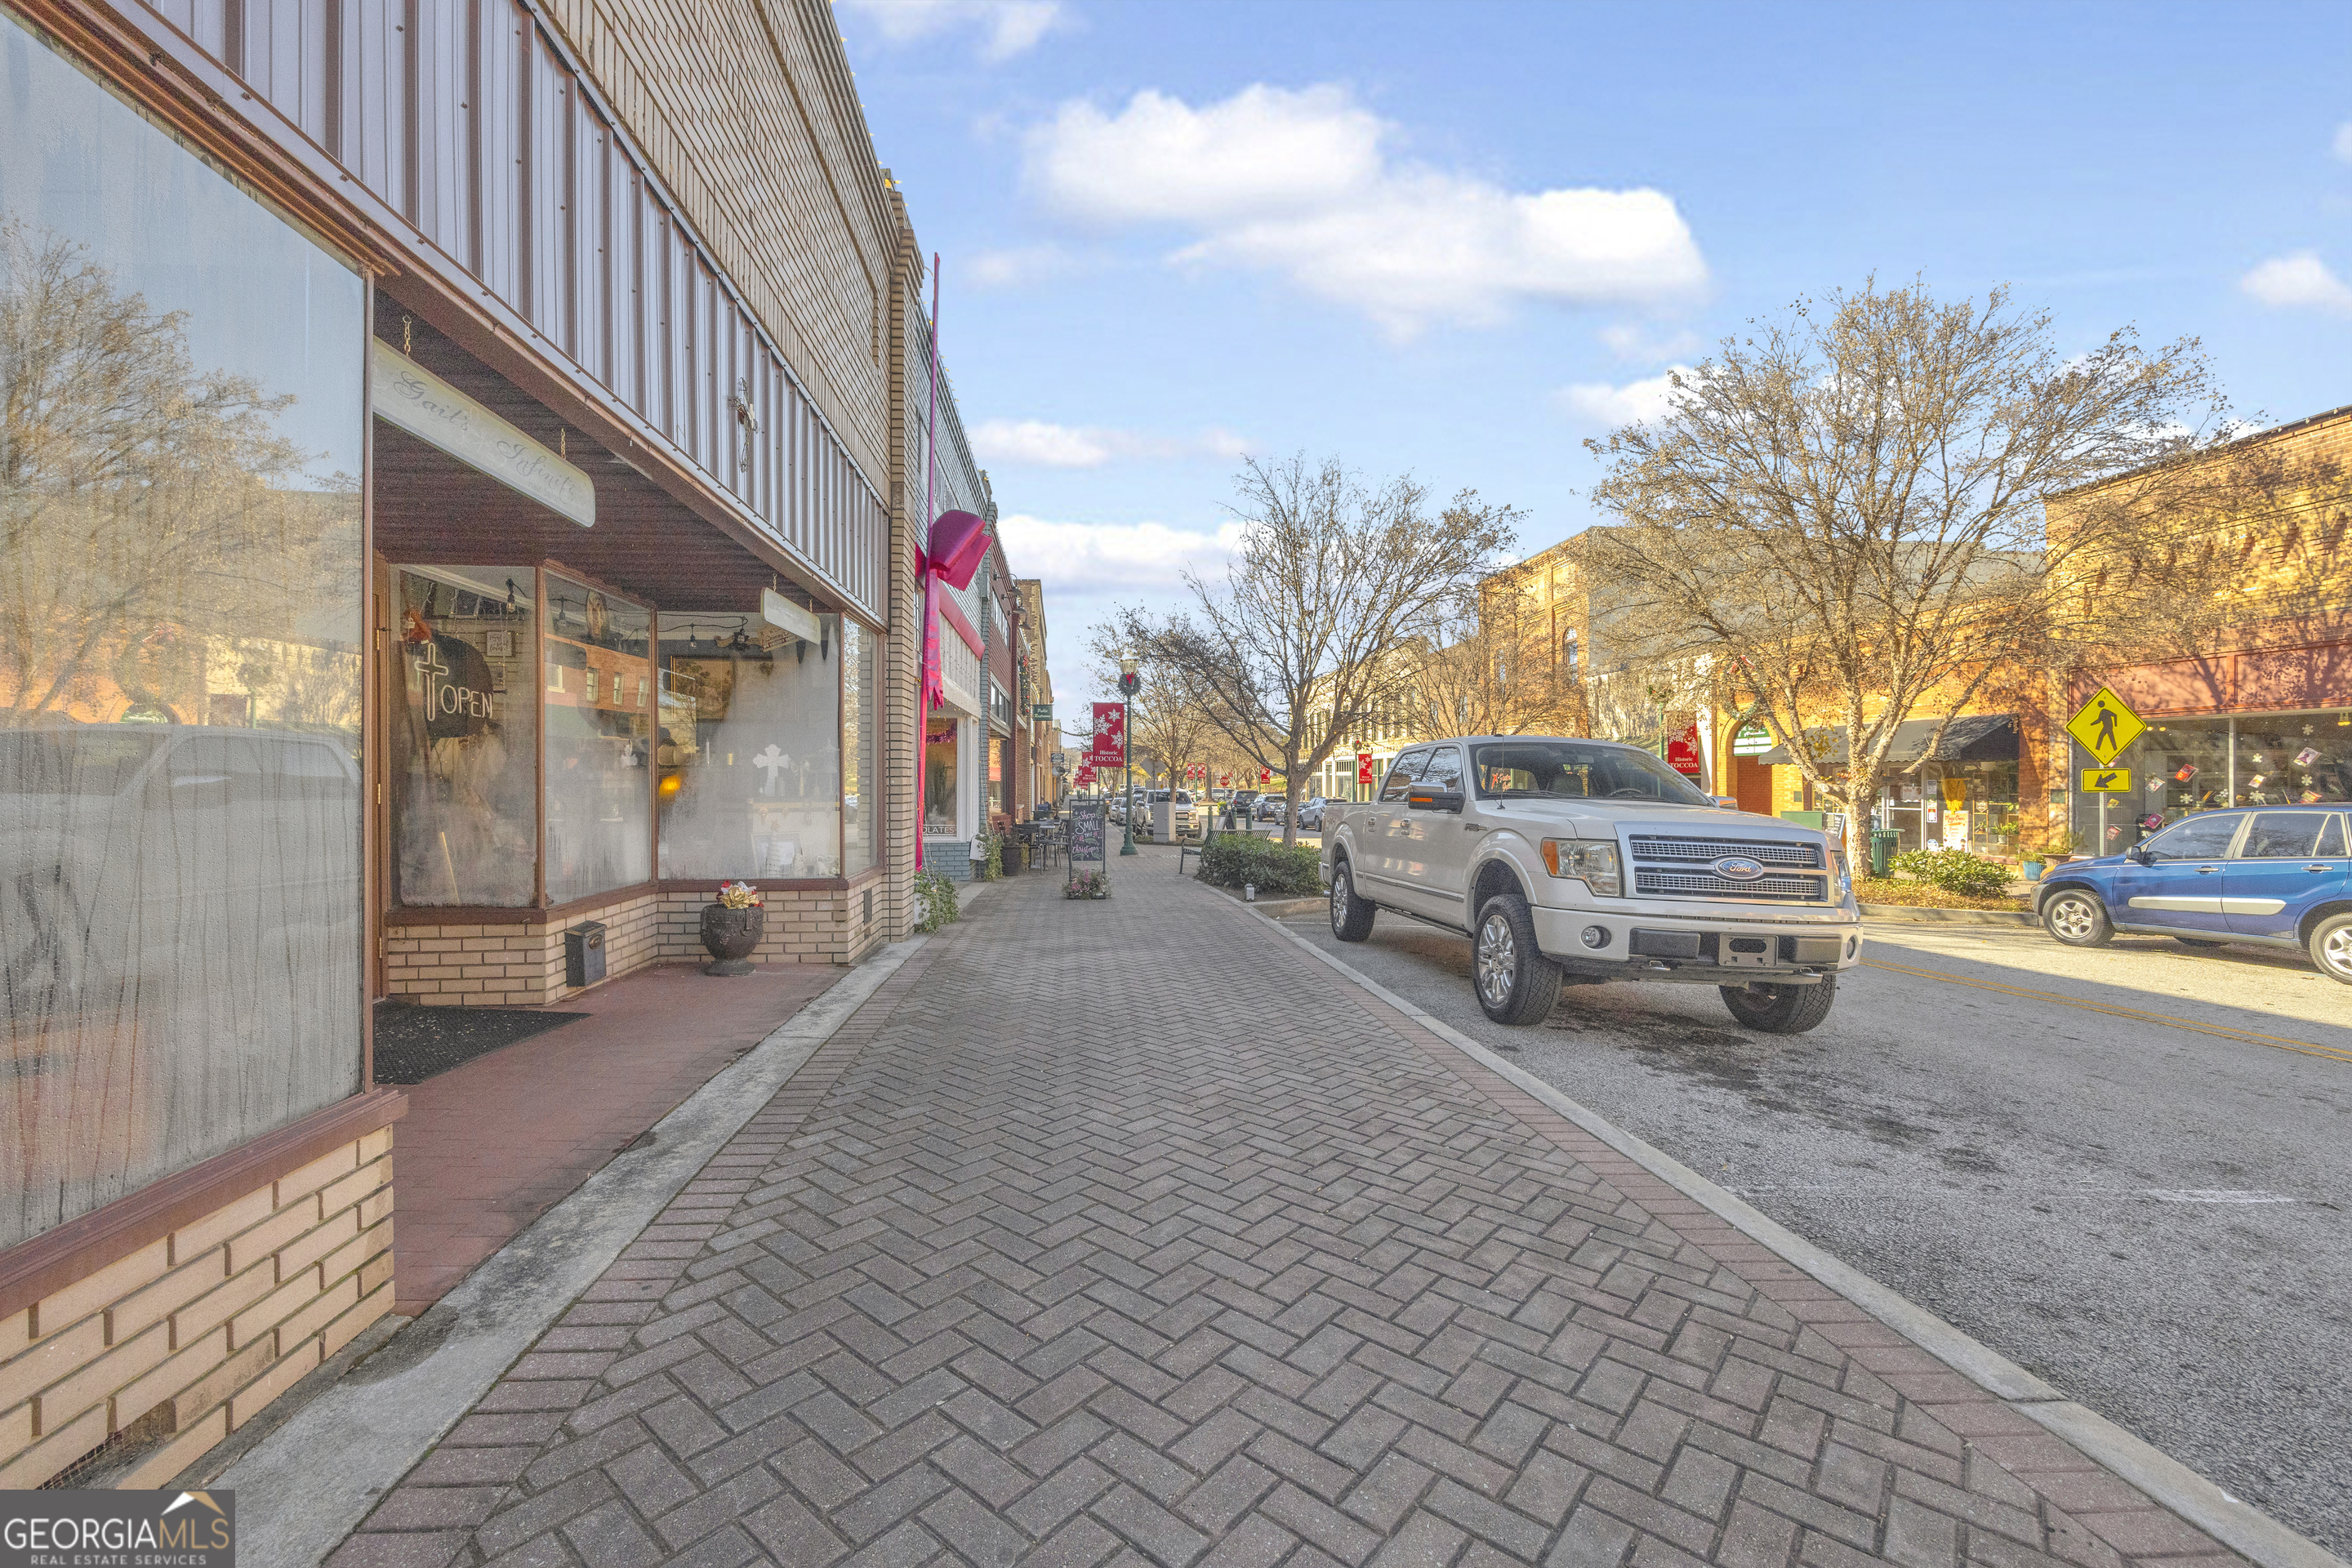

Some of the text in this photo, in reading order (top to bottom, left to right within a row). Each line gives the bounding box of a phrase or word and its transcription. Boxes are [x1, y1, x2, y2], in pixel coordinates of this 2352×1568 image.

[440, 684, 492, 719] OPEN
[1078, 809, 1096, 821] Shop
[1075, 820, 1100, 835] SMALL
[1729, 862, 1752, 872] Ford
